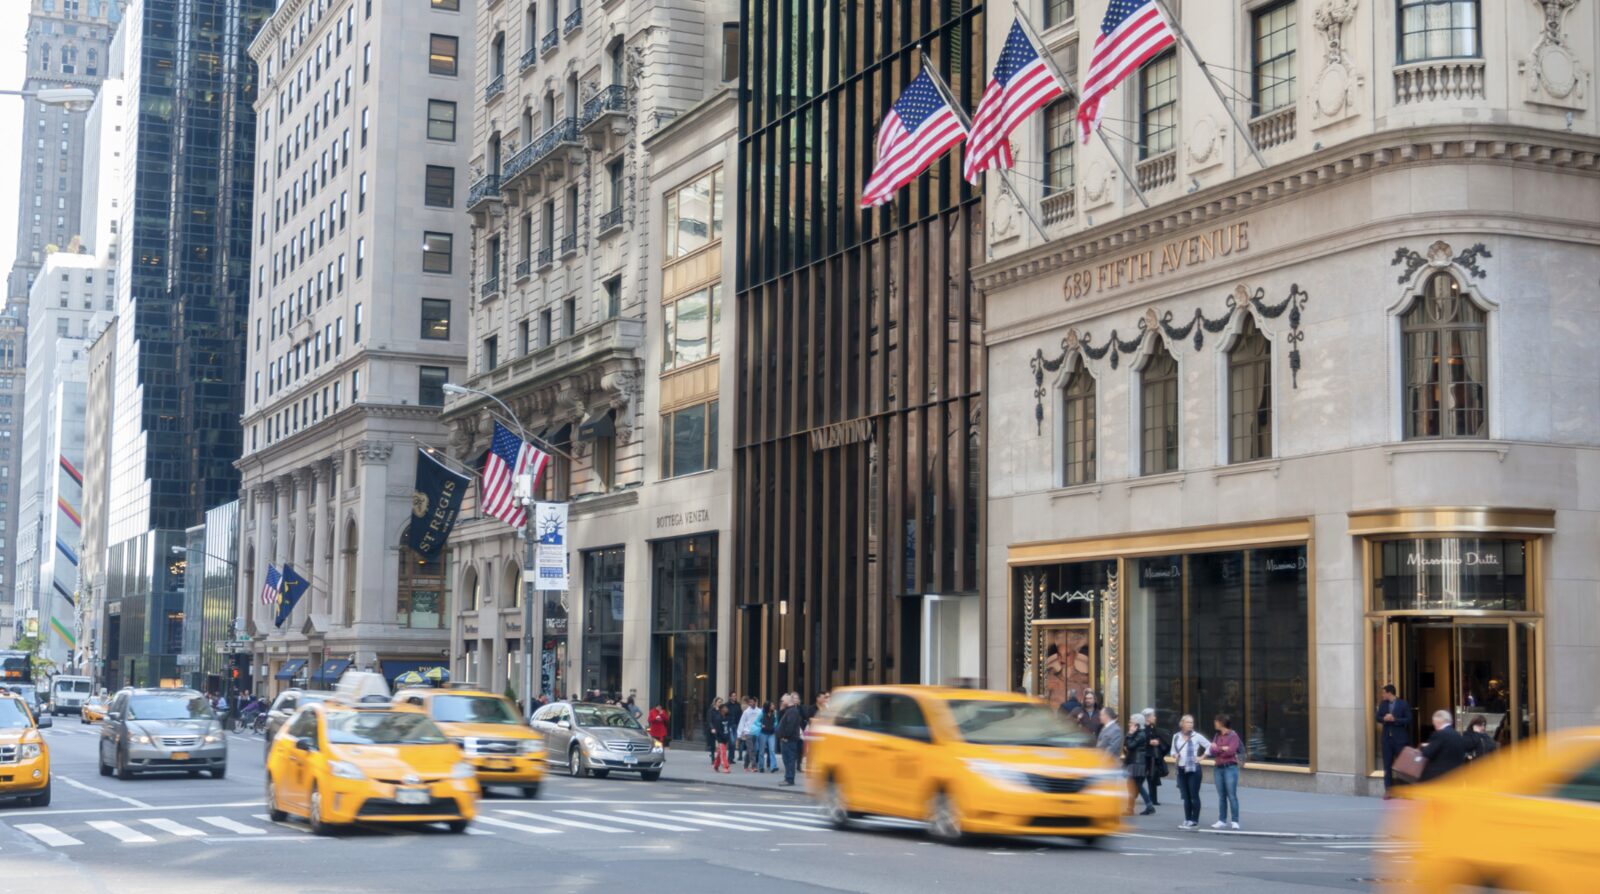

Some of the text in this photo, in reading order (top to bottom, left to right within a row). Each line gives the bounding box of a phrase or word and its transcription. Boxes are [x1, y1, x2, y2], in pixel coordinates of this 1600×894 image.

[1062, 220, 1249, 301] 689 FIFTH AVENUE
[430, 480, 456, 532] REGIS
[656, 508, 710, 529] BOTTEGA VENETA
[1465, 551, 1499, 566] Dutti
